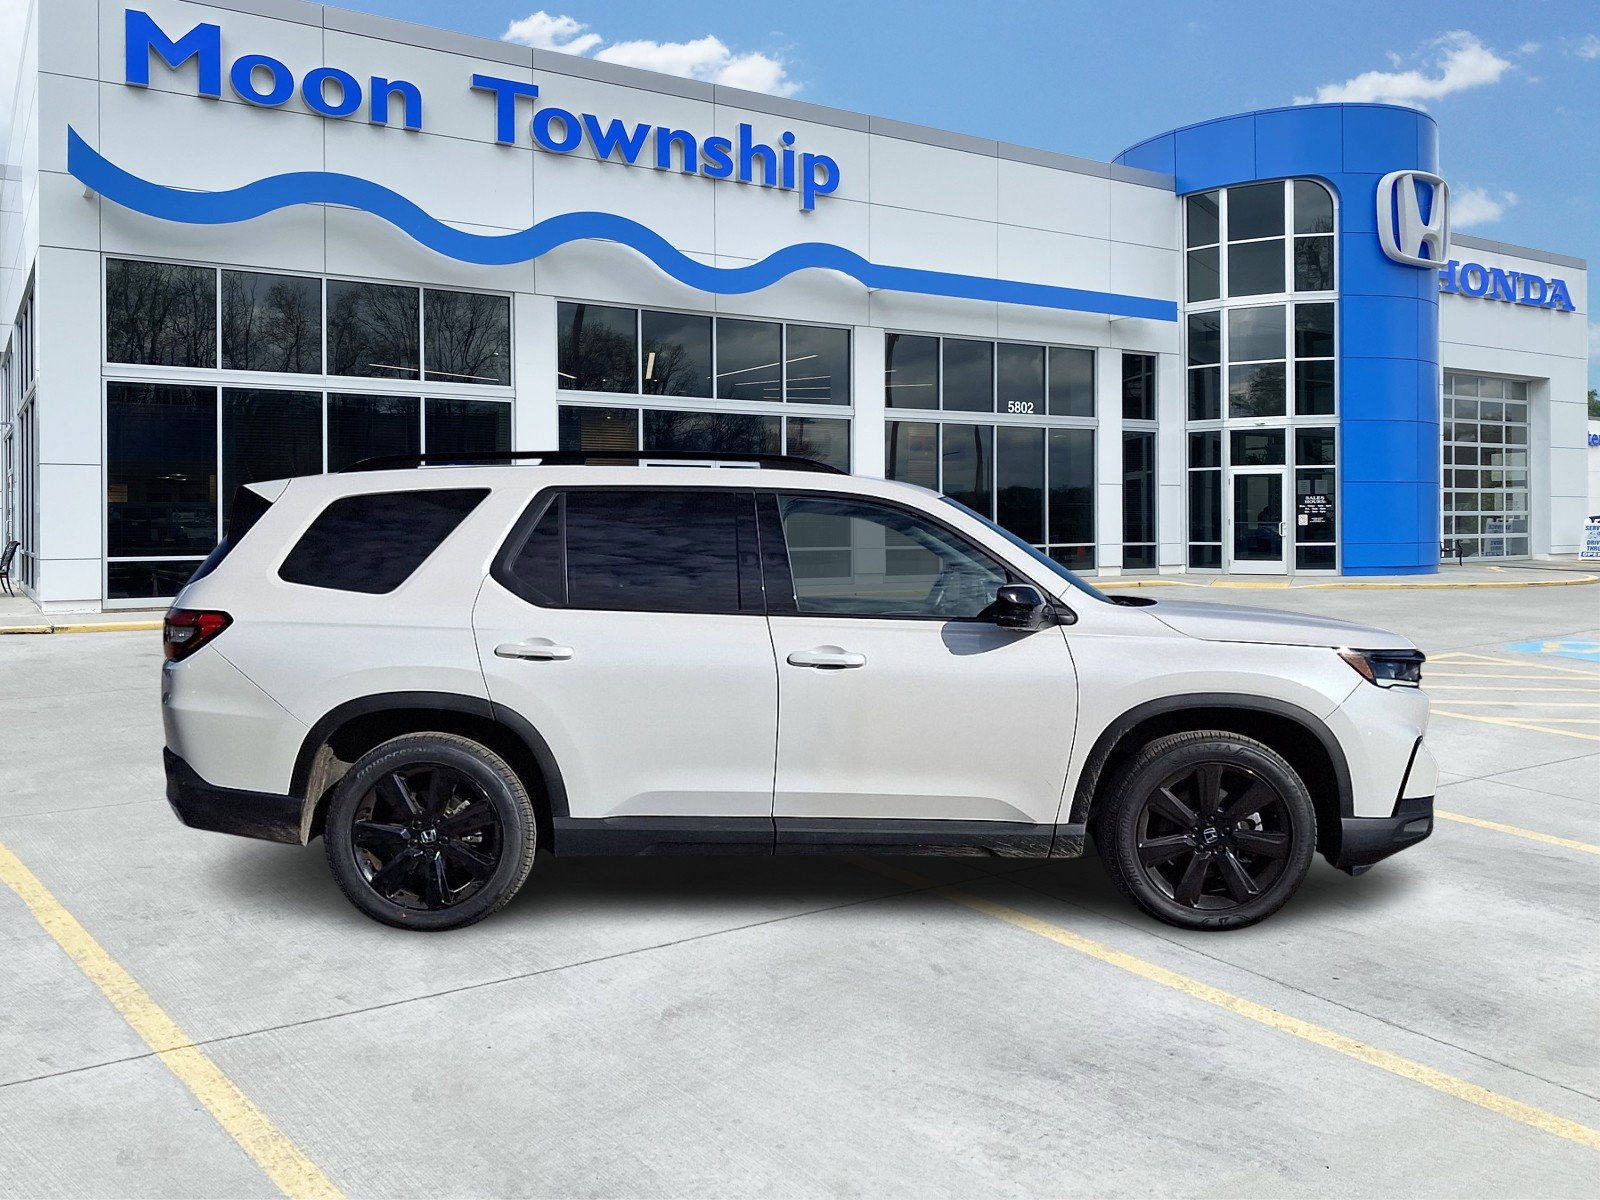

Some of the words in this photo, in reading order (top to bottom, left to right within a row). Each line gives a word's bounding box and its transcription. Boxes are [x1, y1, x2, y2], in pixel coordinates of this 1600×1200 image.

[125, 8, 422, 131] Moon
[469, 73, 840, 212] Township
[1007, 400, 1034, 414] 5802
